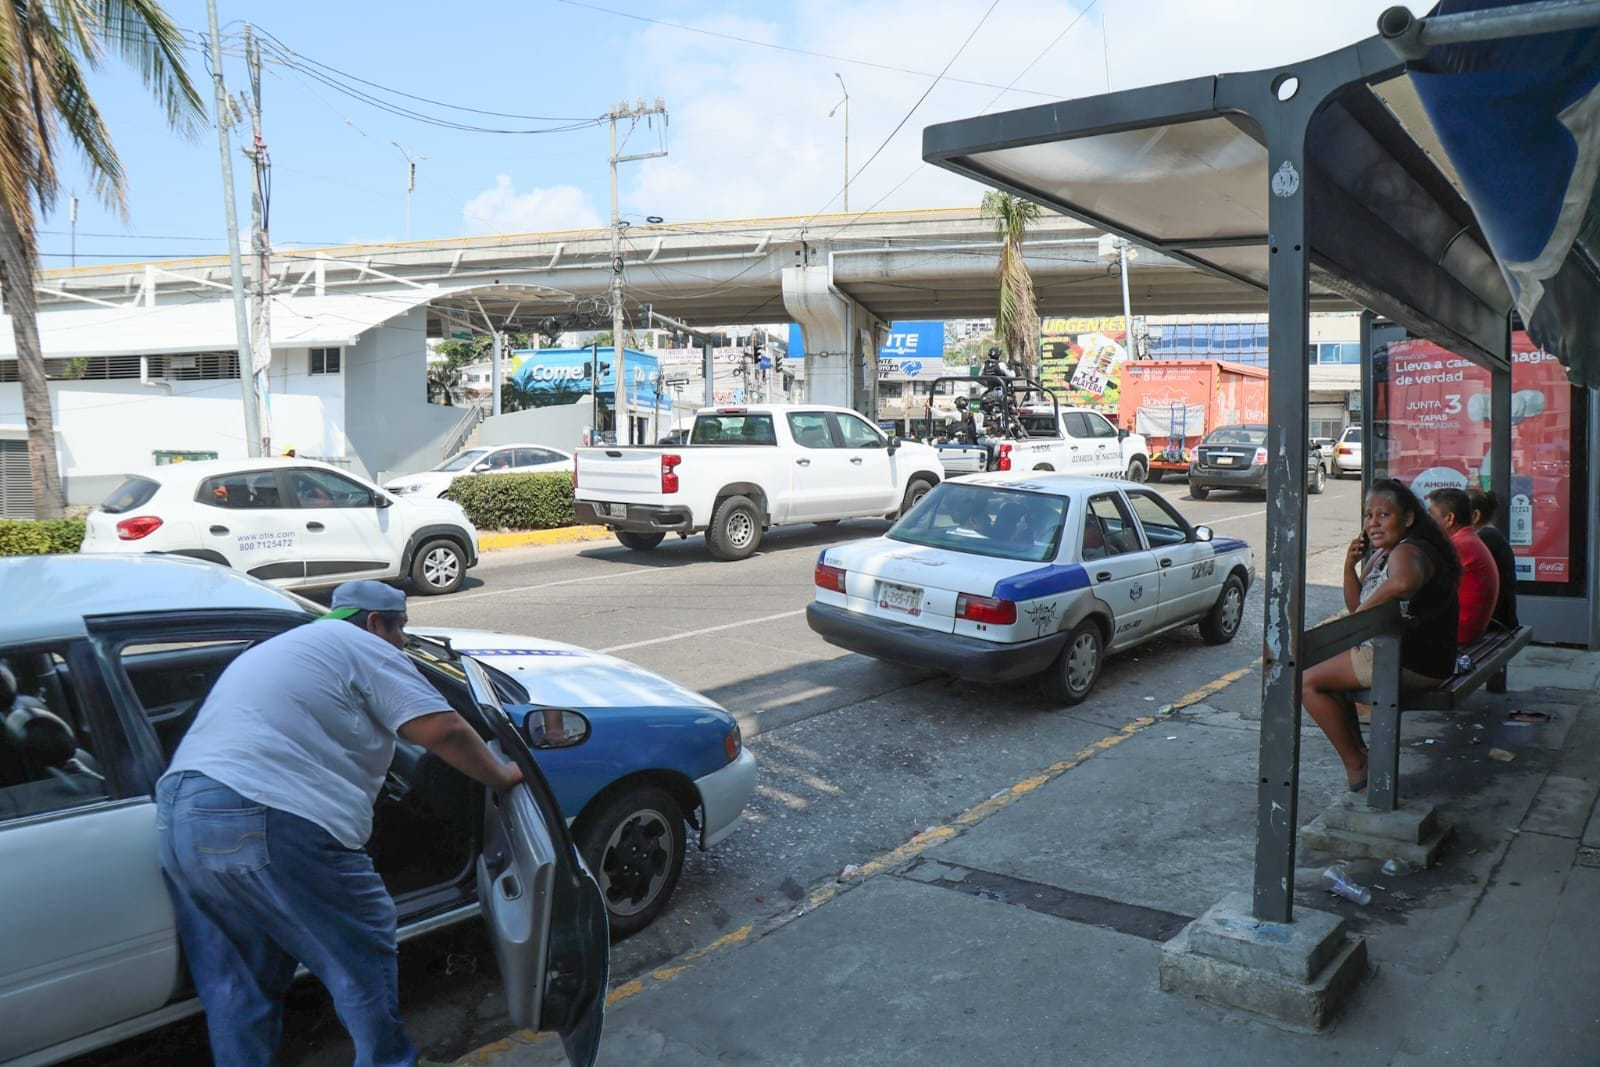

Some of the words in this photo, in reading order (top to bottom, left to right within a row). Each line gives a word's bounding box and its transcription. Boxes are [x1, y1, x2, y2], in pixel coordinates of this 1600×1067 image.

[1395, 360, 1432, 373] Lleva
[1433, 361, 1443, 370] a
[1395, 376, 1413, 386] de
[1415, 370, 1464, 384] verdad
[1071, 375, 1103, 394] PLAYERA
[1407, 400, 1442, 411] JUNTA
[1444, 393, 1462, 415] 3
[1418, 413, 1448, 422] TAPAS
[1423, 480, 1463, 489] AHORRA
[237, 531, 295, 542] www.otis.com
[240, 543, 254, 551] 800
[256, 539, 293, 549] 7125472
